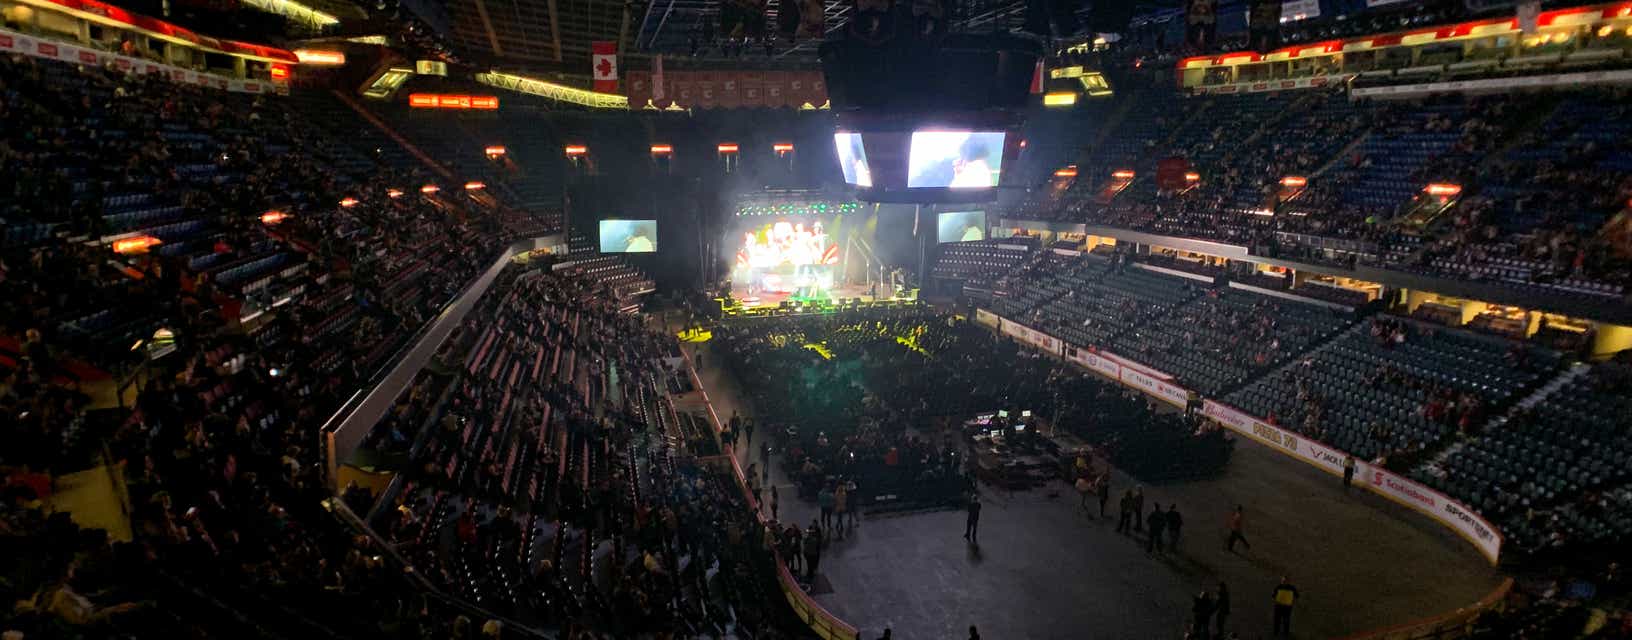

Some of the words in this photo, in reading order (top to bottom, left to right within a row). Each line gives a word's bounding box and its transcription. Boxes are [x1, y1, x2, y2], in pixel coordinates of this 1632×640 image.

[1205, 403, 1245, 426] Budweiser
[1386, 479, 1435, 507] Scotiabank
[1445, 503, 1494, 541] SPORTSNET
